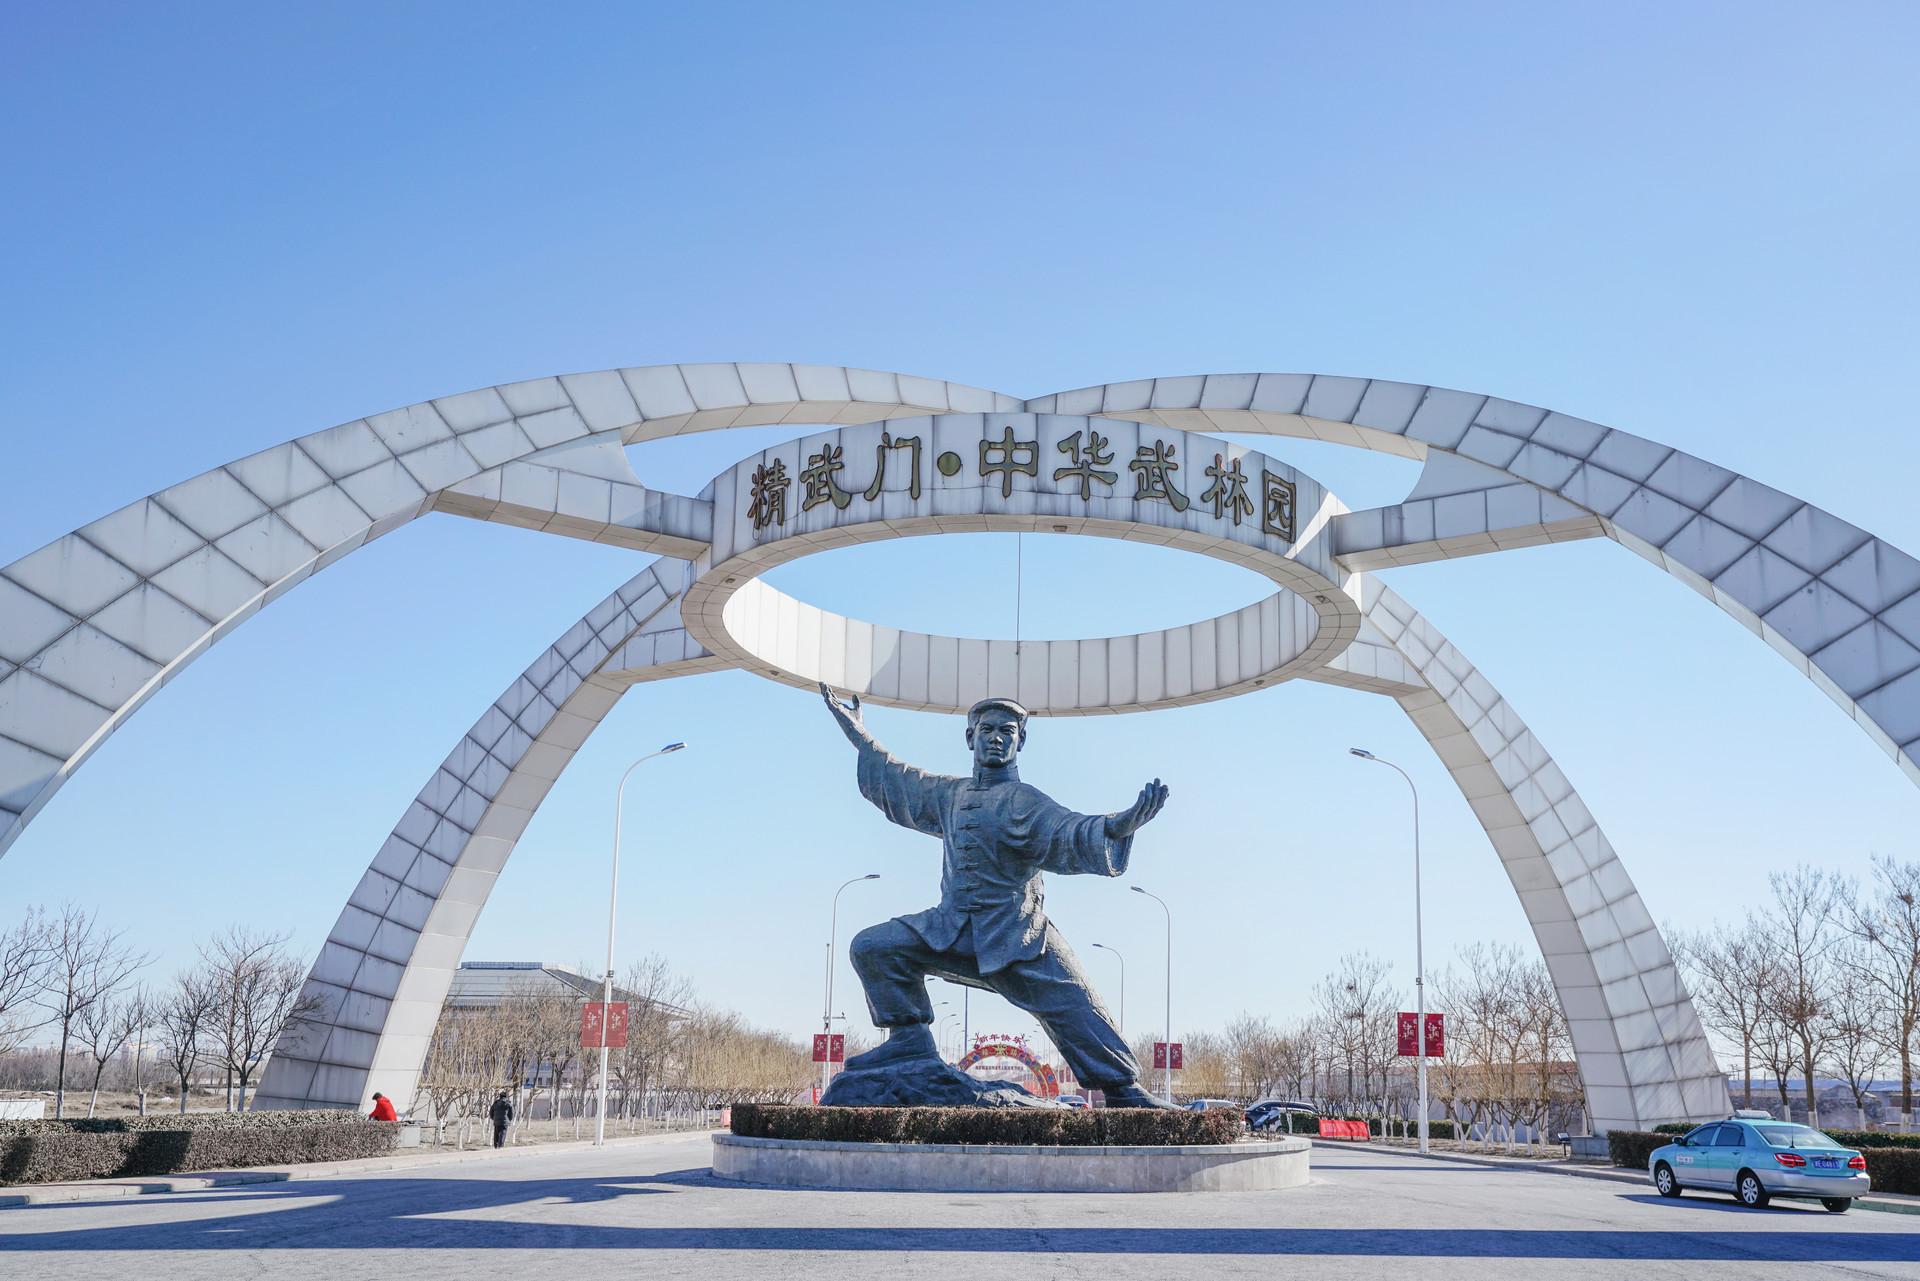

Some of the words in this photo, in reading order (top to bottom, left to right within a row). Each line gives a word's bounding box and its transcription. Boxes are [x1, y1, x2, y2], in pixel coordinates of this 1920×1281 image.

[748, 426, 1296, 543] 精武门·中华武林园
[979, 1033, 1023, 1045] 新年快乐
